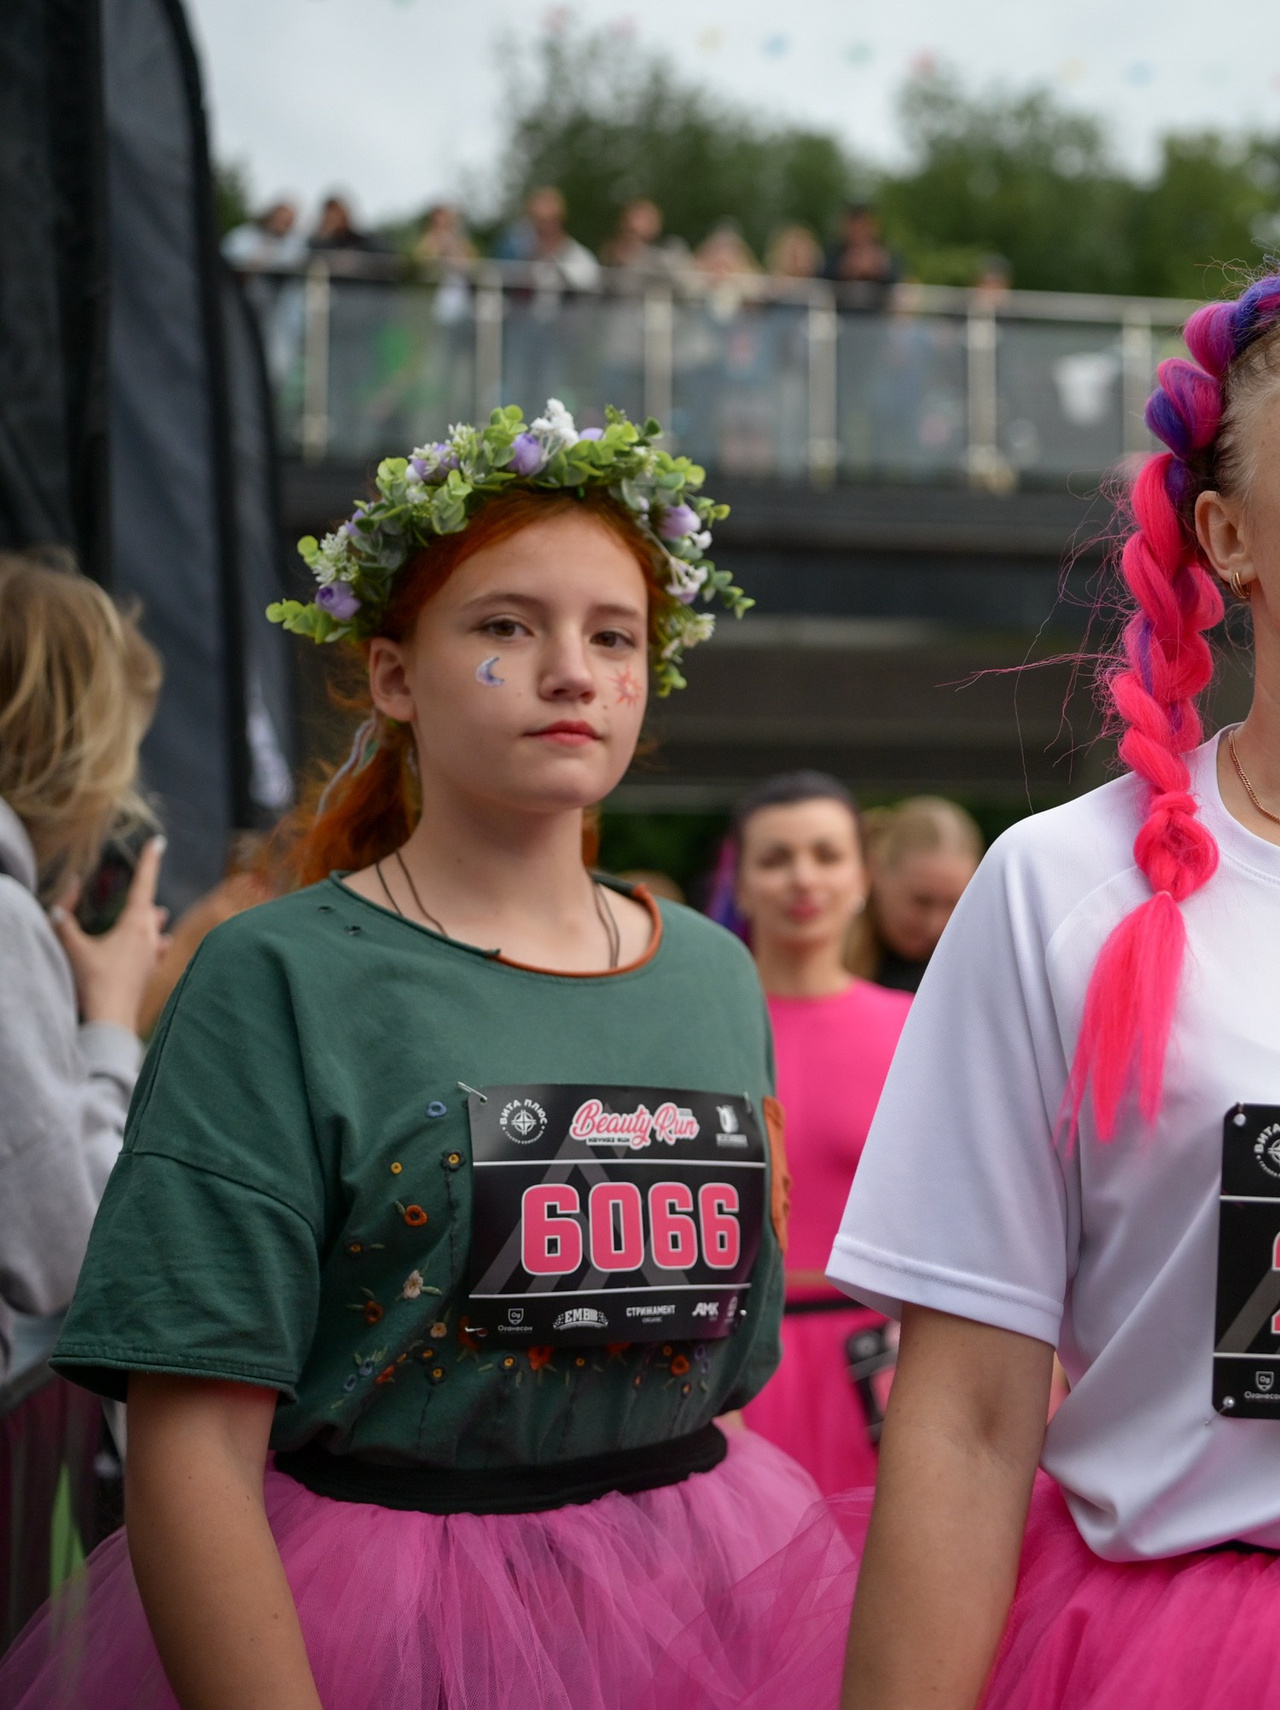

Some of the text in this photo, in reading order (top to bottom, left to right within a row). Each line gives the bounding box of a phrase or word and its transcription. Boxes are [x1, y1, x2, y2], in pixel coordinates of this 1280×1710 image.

[499, 1098, 548, 1125] ВИТА ПЛЮС
[570, 1099, 699, 1149] Beauty Run
[521, 1181, 740, 1276] 6066
